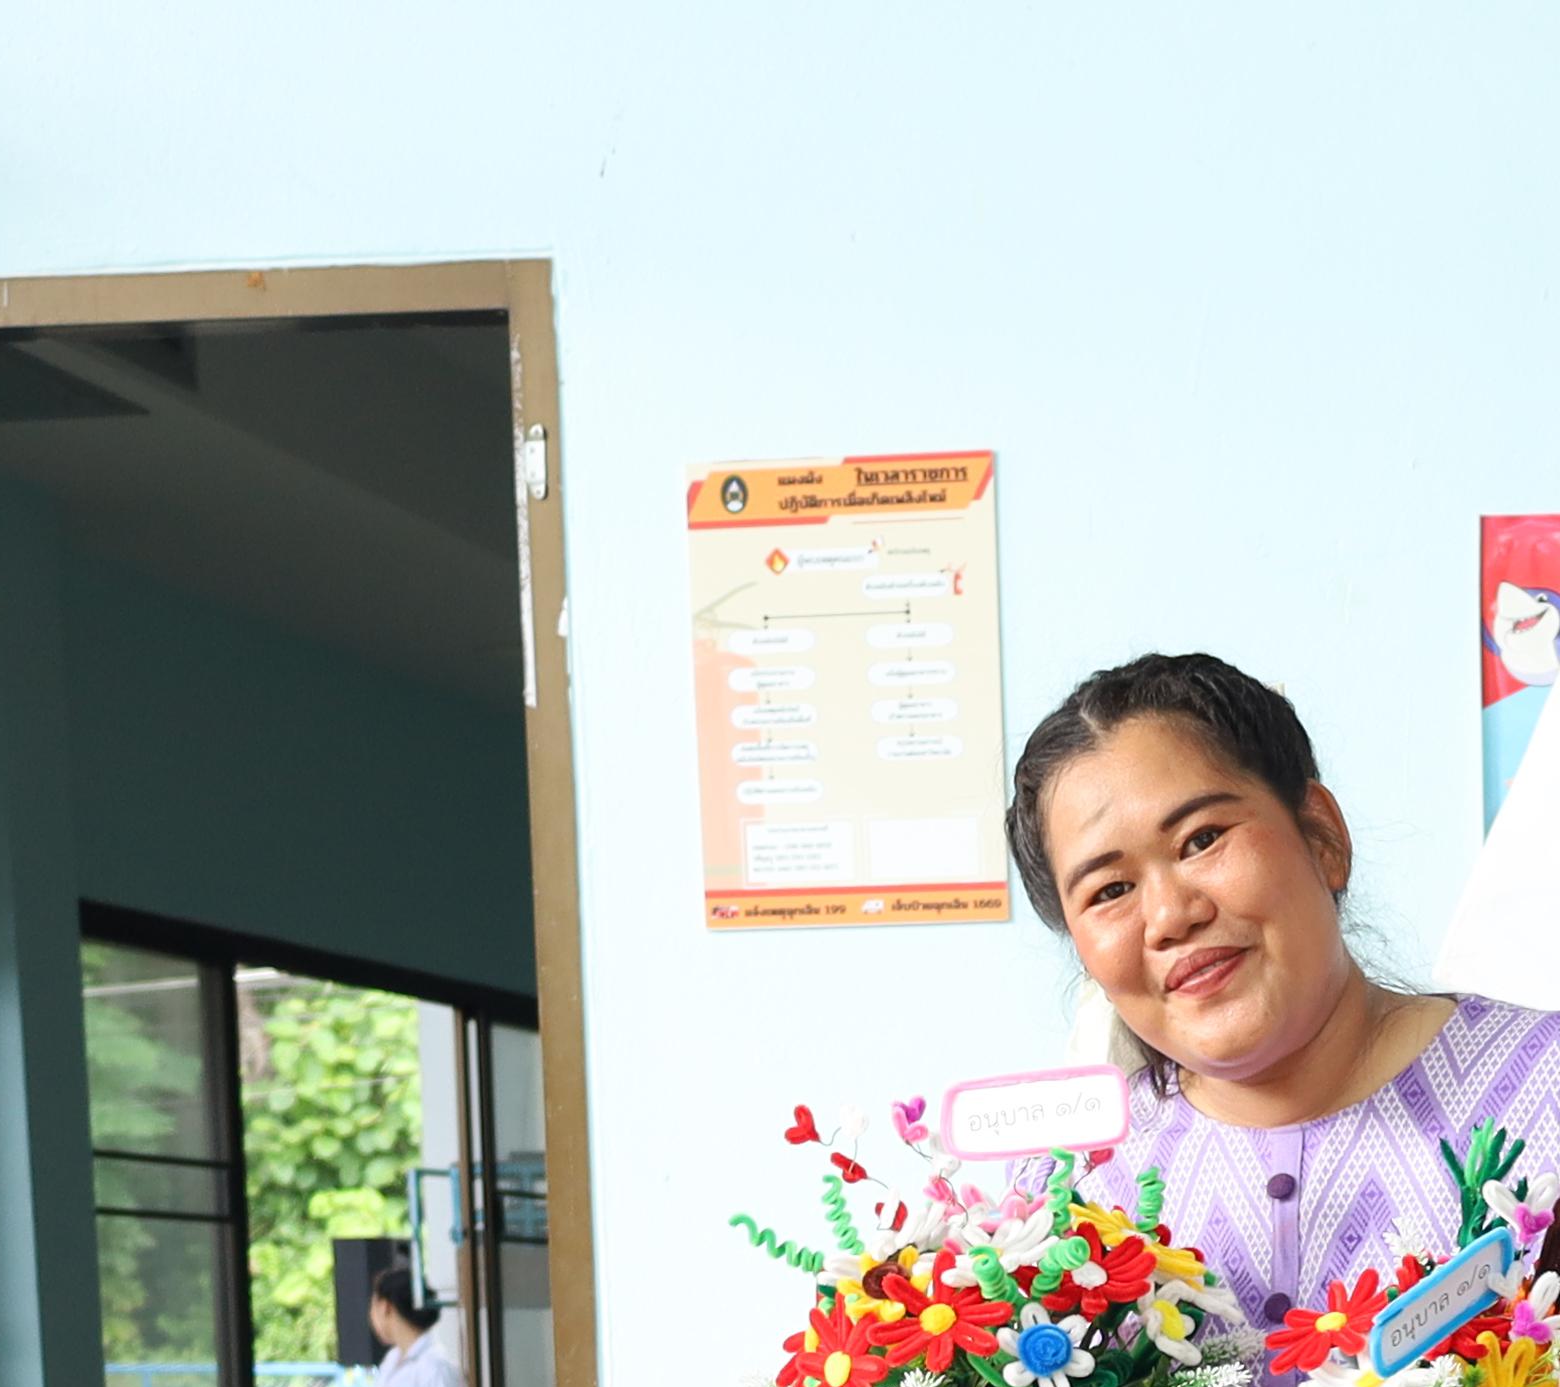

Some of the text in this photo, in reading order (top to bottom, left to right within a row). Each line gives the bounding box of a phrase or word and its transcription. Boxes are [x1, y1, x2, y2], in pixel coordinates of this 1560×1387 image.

[825, 905, 846, 916] 199
[968, 1103, 1045, 1135] อนุบาล
[1390, 1293, 1450, 1347] อนุบาล
